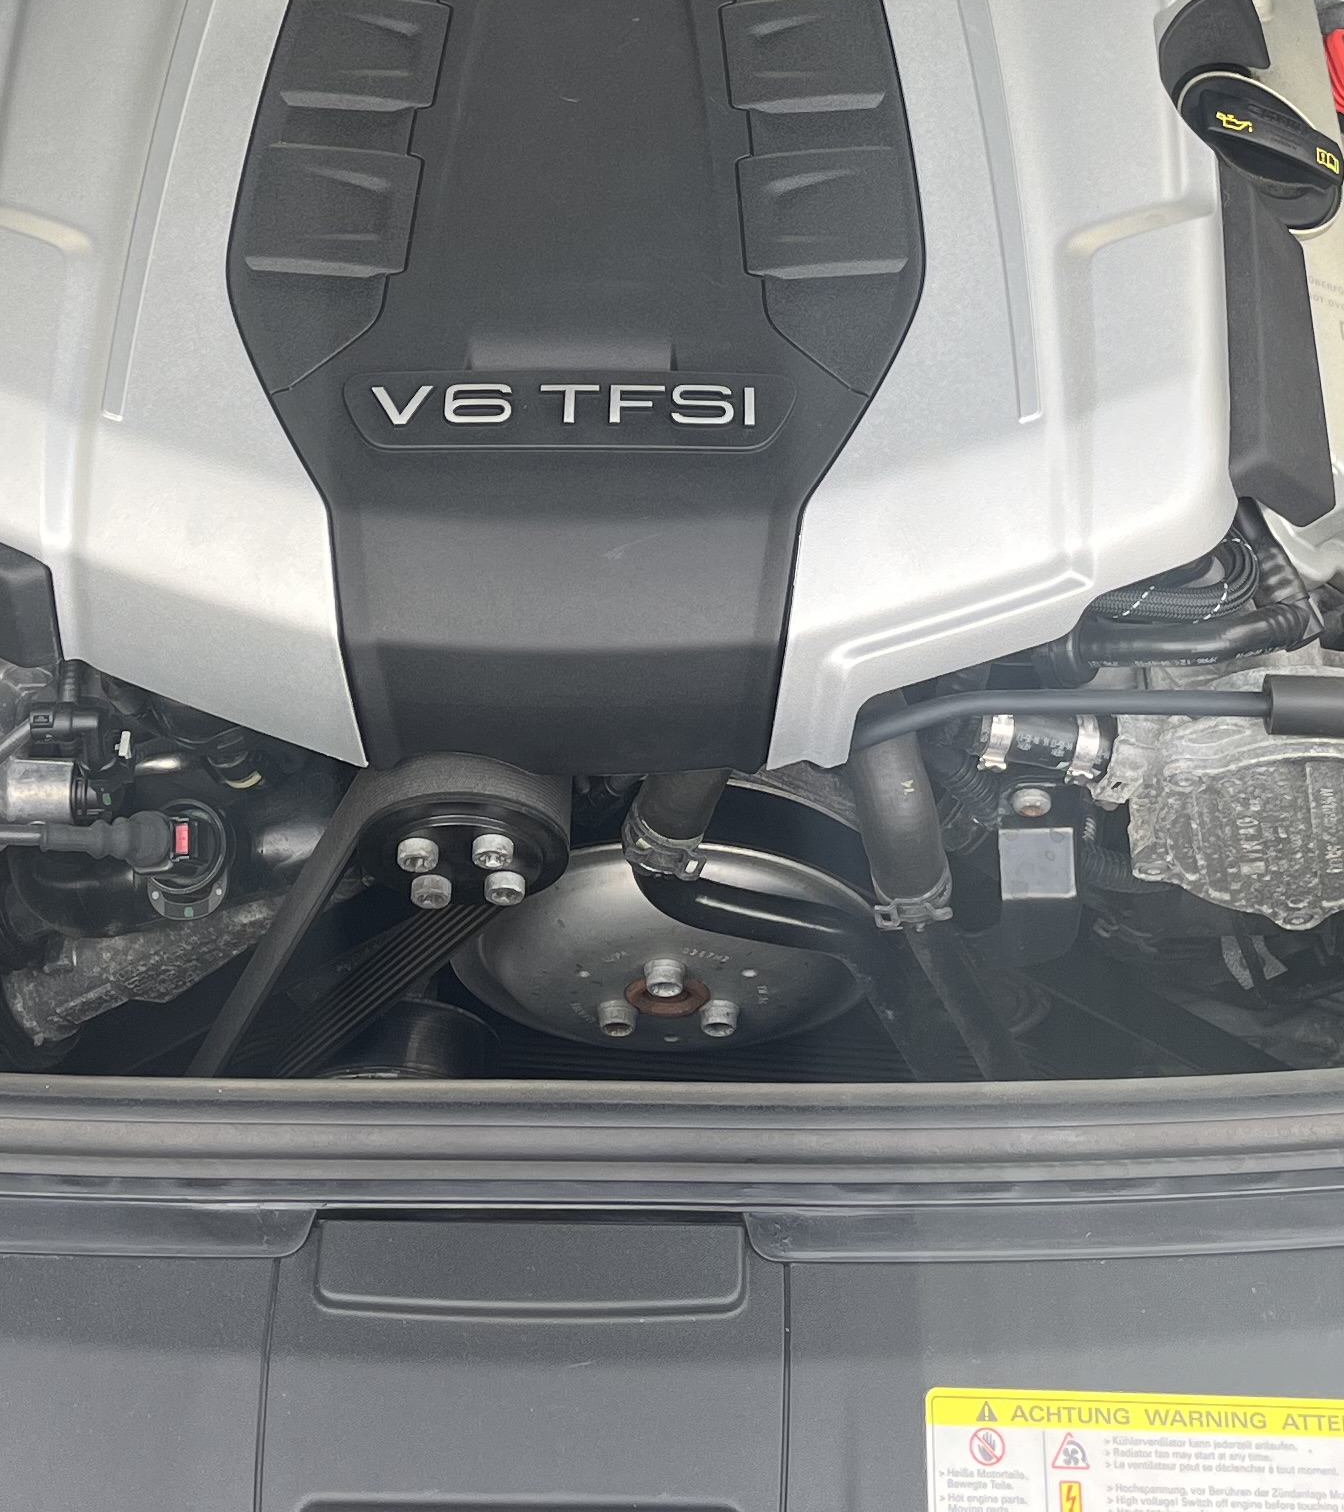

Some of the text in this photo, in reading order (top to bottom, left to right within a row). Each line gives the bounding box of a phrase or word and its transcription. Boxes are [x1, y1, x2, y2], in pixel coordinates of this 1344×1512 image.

[371, 383, 757, 426] V6 TFSI
[1010, 1404, 1131, 1426] ACHTUNG
[1144, 1408, 1268, 1431] WARNING
[1172, 1451, 1193, 1461] may
[948, 1492, 965, 1503] Hot
[966, 1494, 999, 1505] engine
[1116, 1495, 1139, 1507] High
